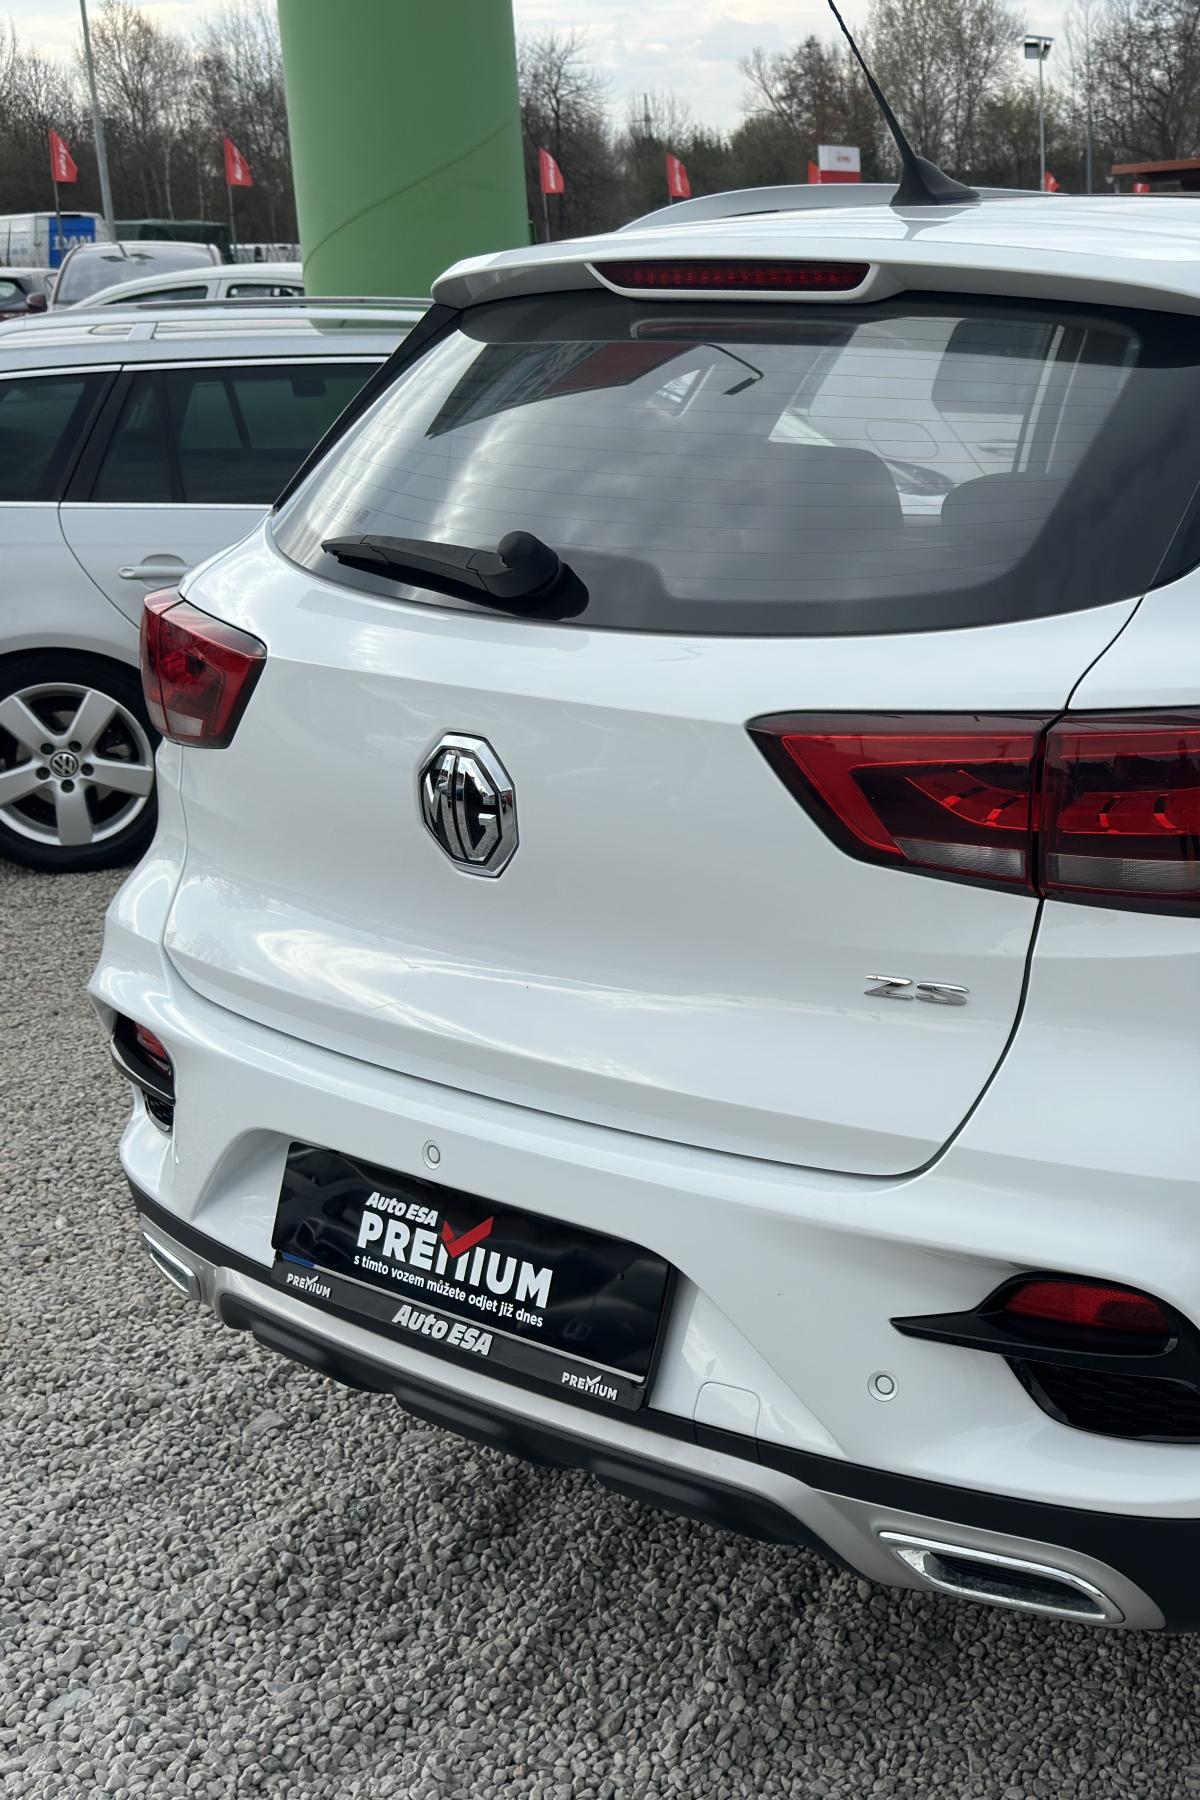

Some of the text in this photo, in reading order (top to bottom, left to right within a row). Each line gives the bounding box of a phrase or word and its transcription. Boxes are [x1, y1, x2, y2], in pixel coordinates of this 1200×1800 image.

[420, 753, 501, 862] MG
[863, 973, 970, 1006] ZS
[365, 1191, 439, 1227] Auto ESA
[357, 1210, 554, 1309] PREMIUM
[286, 1272, 332, 1298] PREMIUM
[353, 1255, 544, 1328] s tímto vozem můžete odjet již dnes
[391, 1304, 494, 1356] Auto ESA
[561, 1371, 618, 1401] PREMIUM
